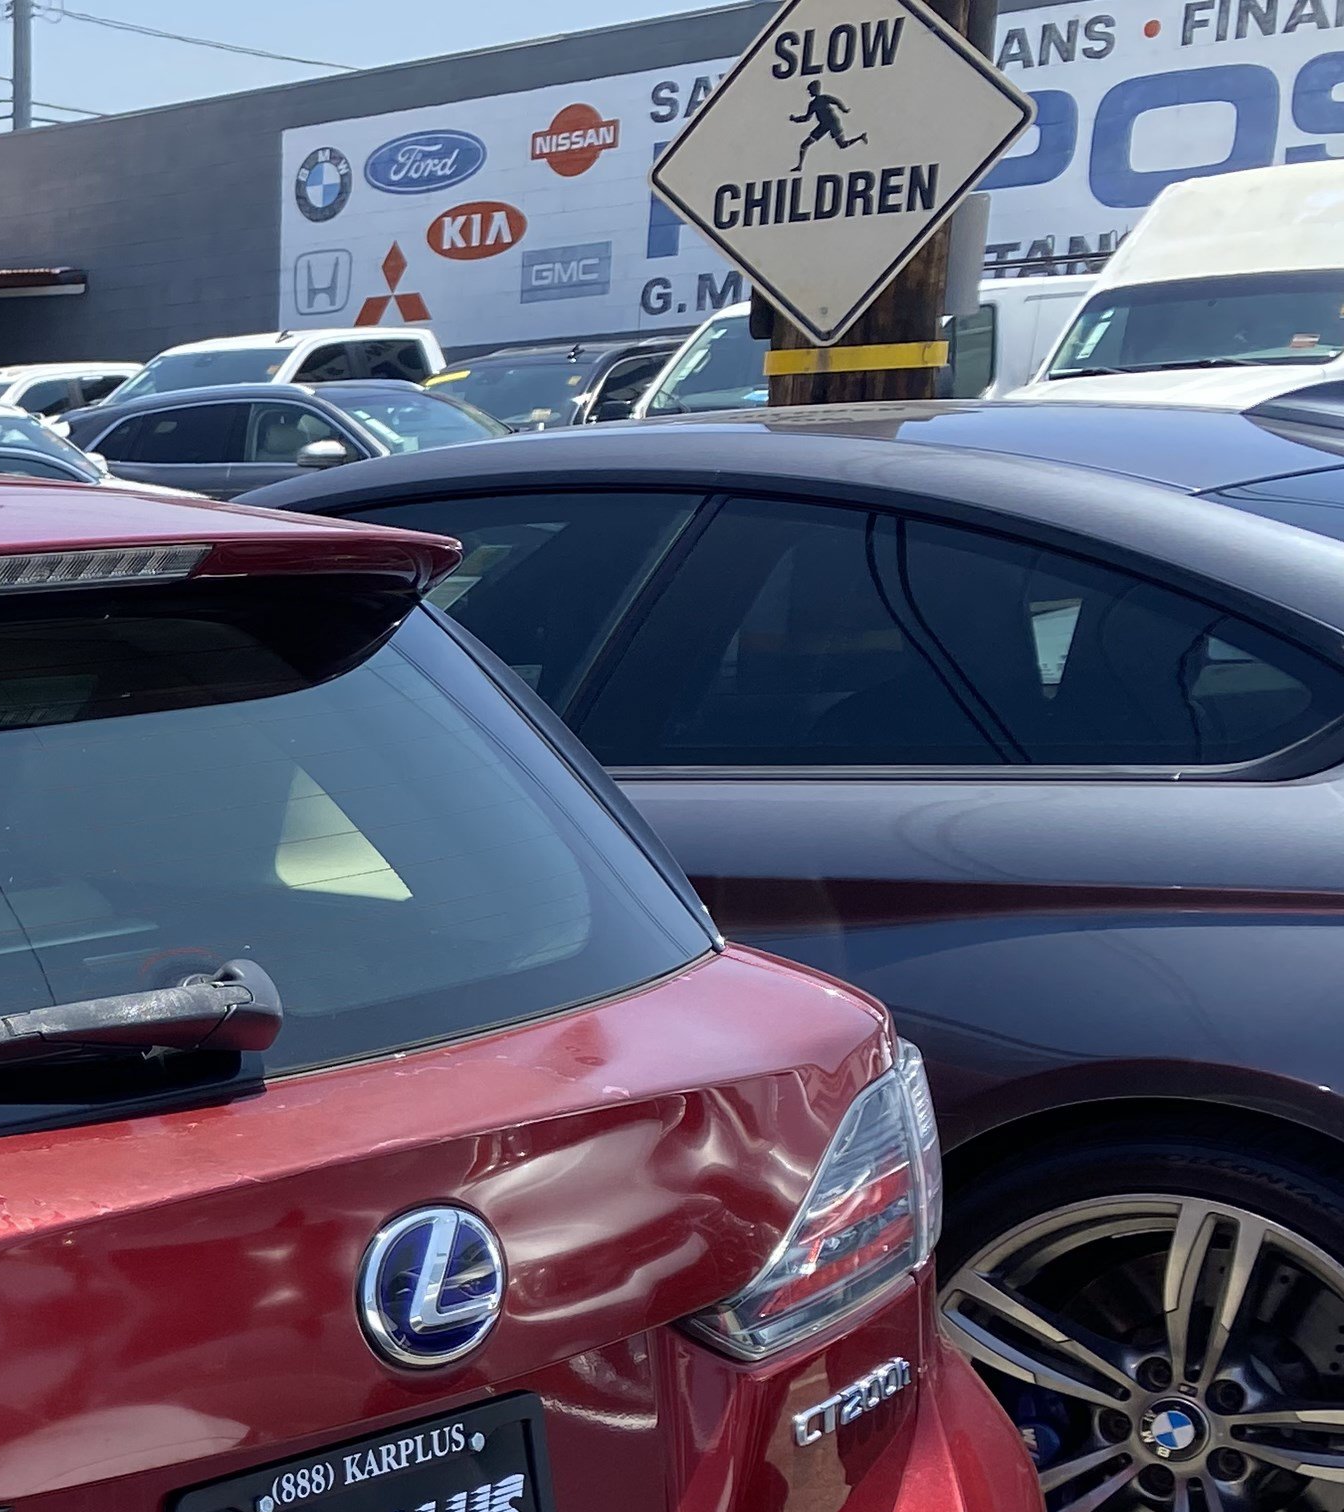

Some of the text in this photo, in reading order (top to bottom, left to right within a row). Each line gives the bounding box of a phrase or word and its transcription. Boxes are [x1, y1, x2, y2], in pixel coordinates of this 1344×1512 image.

[650, 73, 724, 123] SA
[1181, 0, 1344, 46] FINA
[772, 18, 906, 80] SLOW
[390, 143, 460, 182] Ford
[535, 125, 614, 154] NISSAN
[713, 163, 939, 230] CHILDREN
[442, 211, 512, 250] KIA
[985, 230, 1132, 279] TAN
[531, 257, 600, 287] GMC
[270, 1423, 465, 1504] (888) KARPLUS
